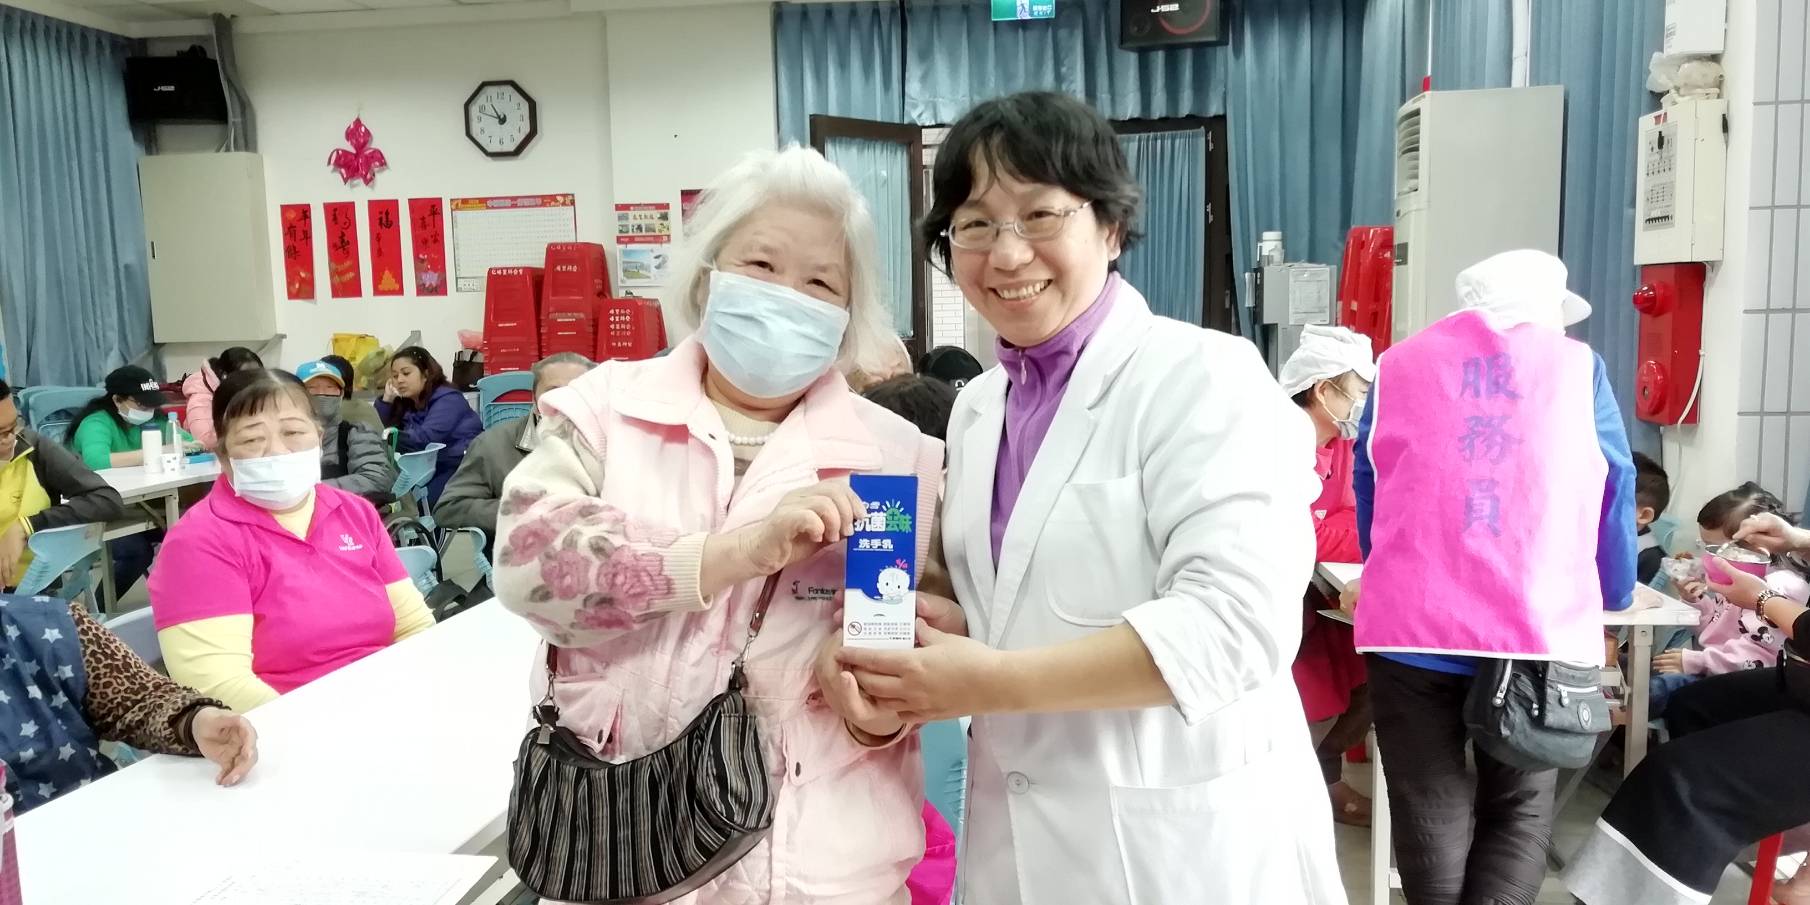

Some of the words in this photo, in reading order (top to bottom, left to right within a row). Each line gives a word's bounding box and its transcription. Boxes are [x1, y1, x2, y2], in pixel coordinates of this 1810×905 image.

[1457, 352, 1525, 537] 服務員
[859, 538, 893, 549] 洗手乳
